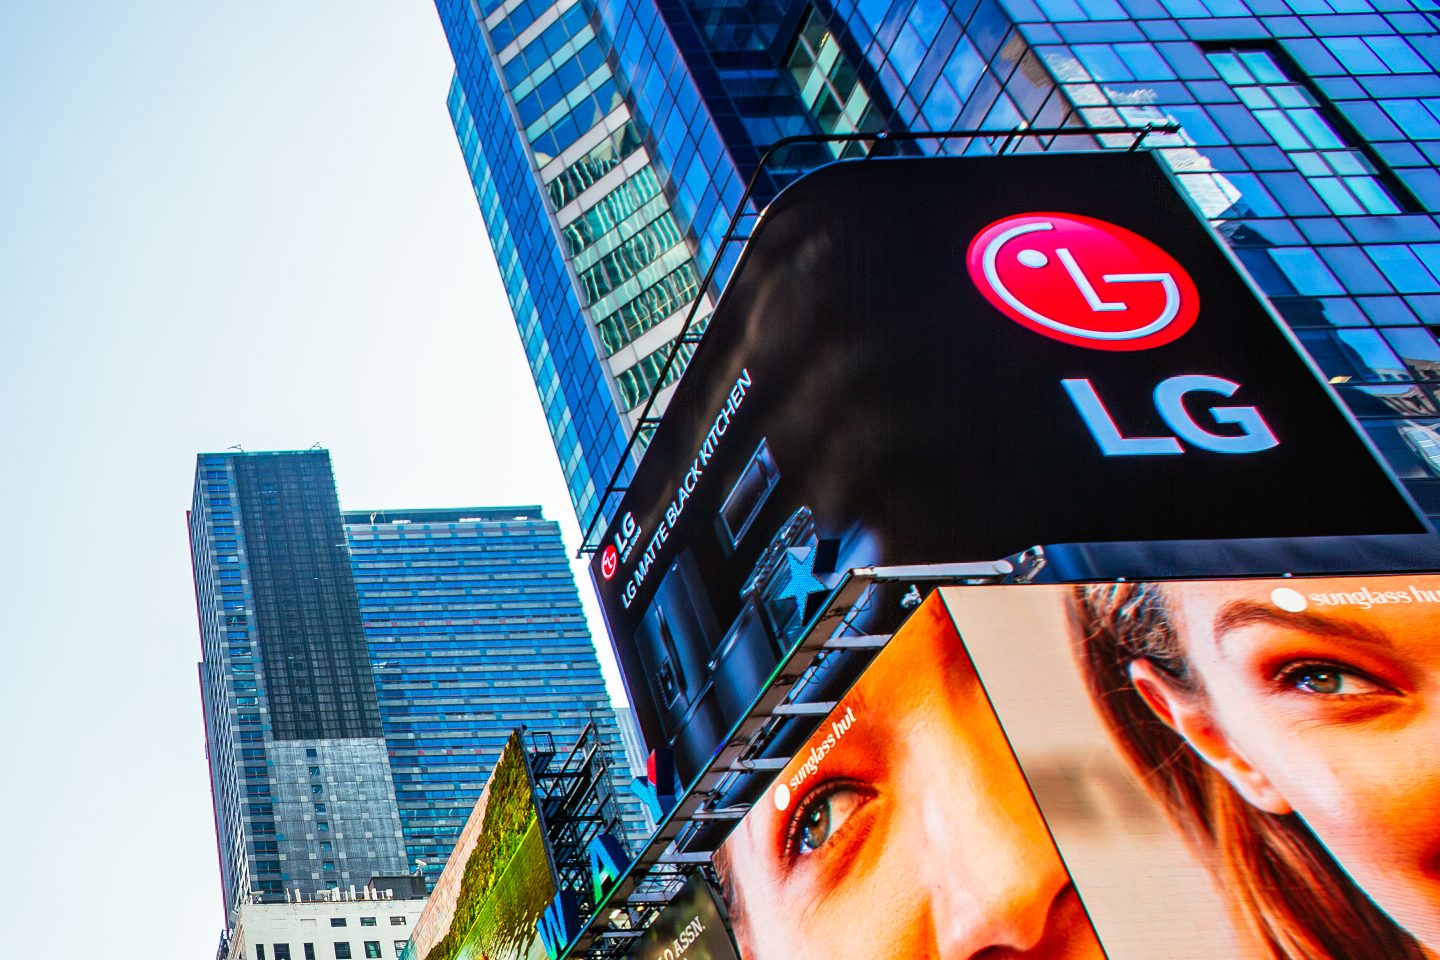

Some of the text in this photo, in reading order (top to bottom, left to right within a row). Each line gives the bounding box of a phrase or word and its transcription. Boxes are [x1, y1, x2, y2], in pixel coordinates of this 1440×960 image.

[1060, 373, 1281, 457] LG
[620, 580, 639, 610] LG
[633, 520, 670, 588] MATTE
[664, 458, 702, 529] BLACK
[698, 367, 753, 467] KITCHEN
[614, 511, 637, 555] LG
[1309, 584, 1440, 610] sunglass hu
[790, 706, 857, 792] sunglass hut
[672, 915, 706, 958] ASSN.
